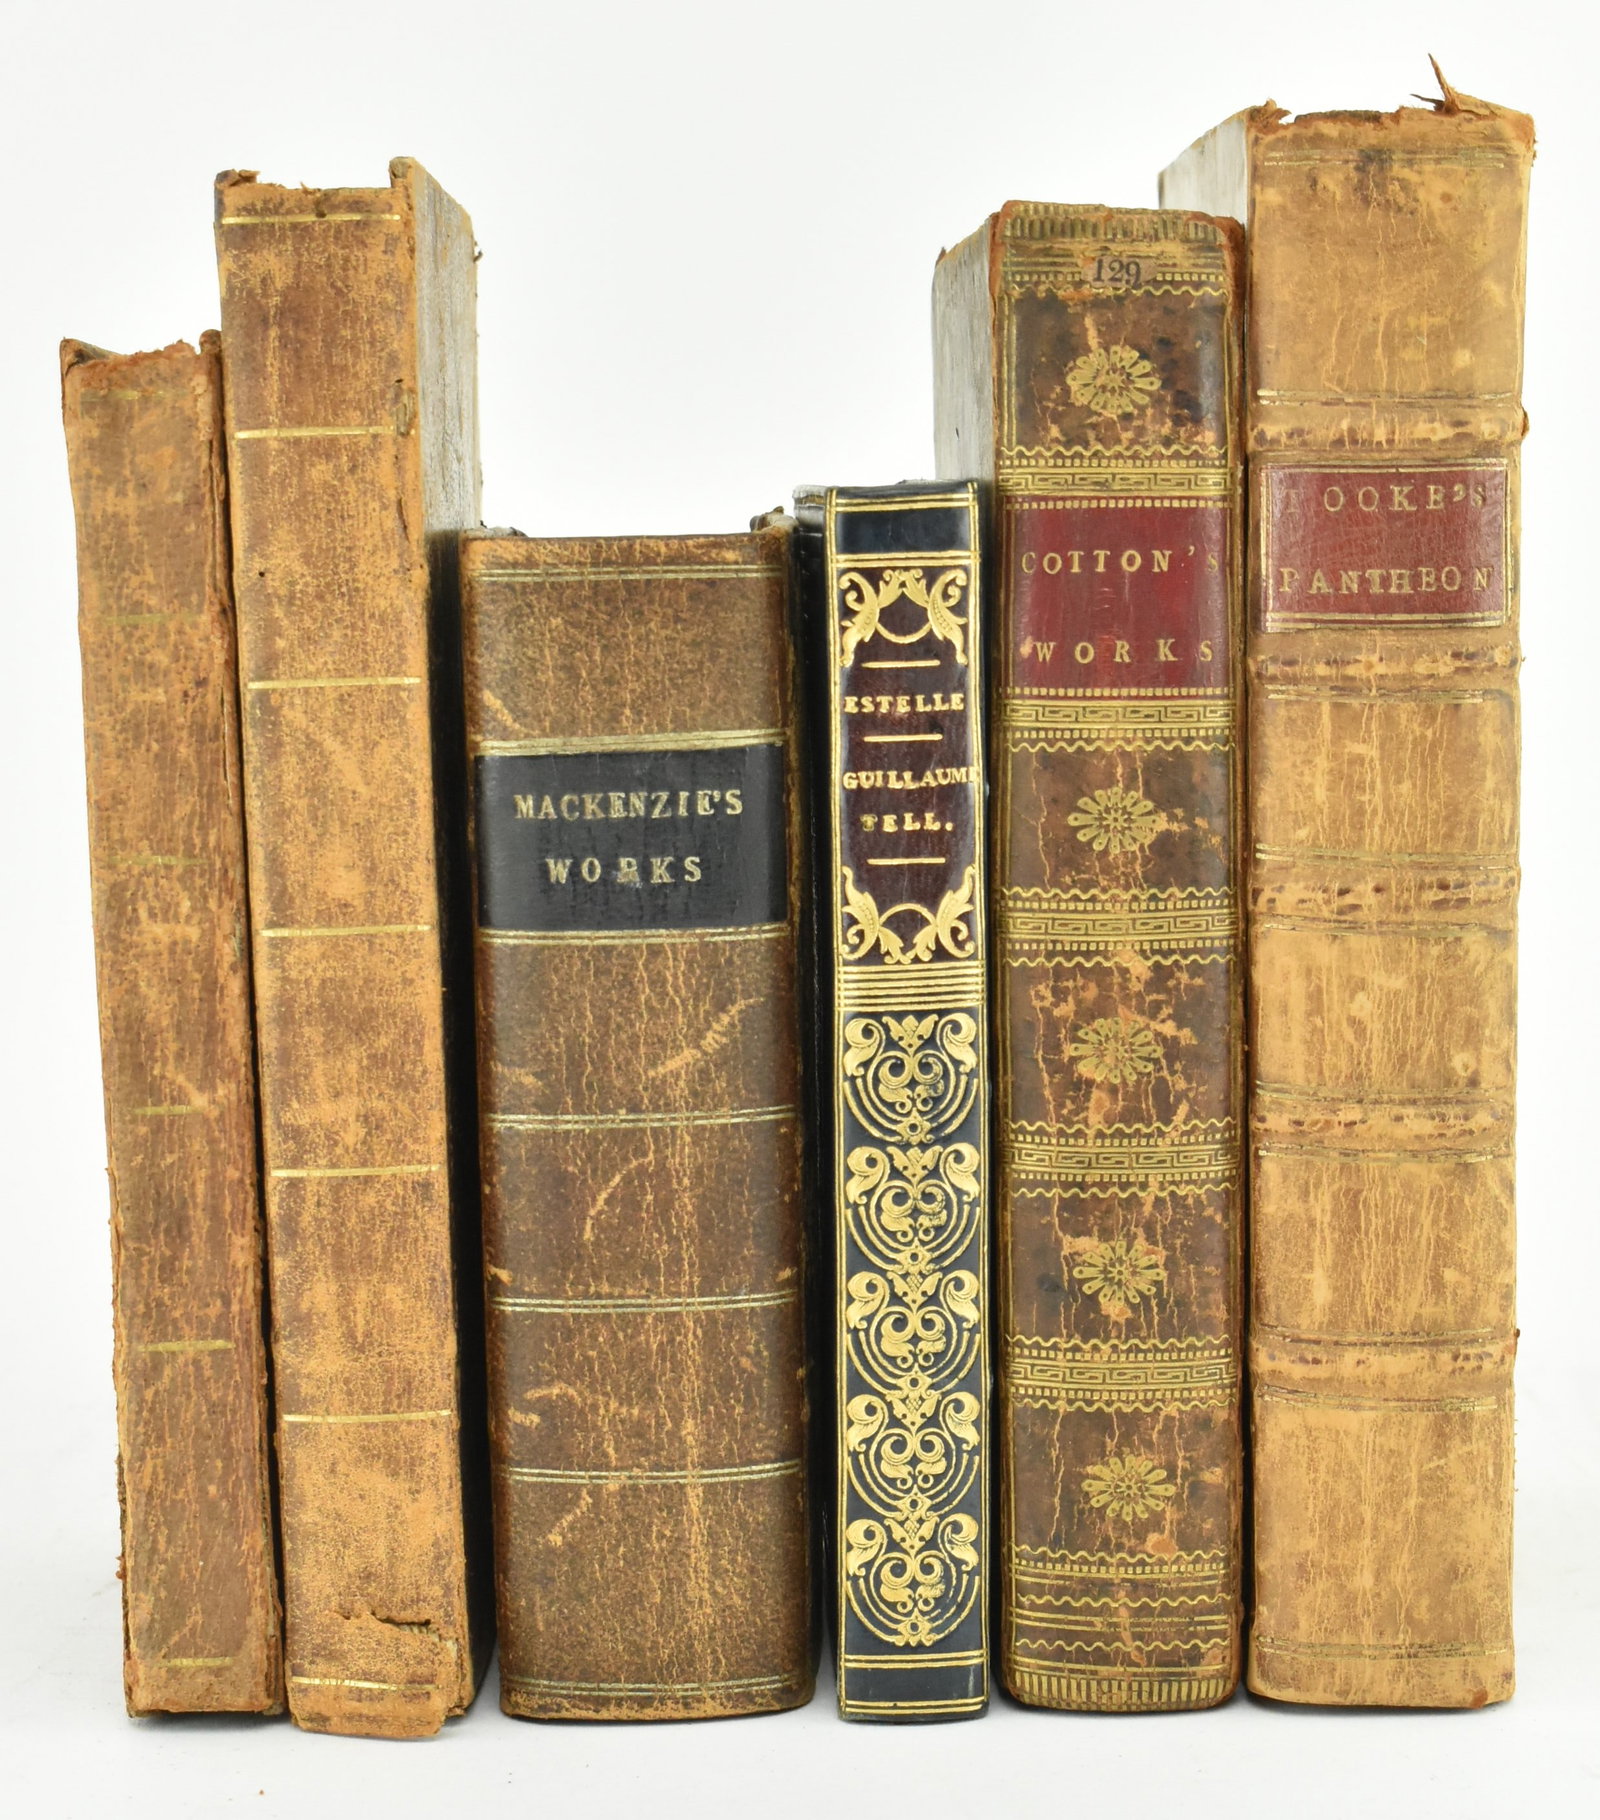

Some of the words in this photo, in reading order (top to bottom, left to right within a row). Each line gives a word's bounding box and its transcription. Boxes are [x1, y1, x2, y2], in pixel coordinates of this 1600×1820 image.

[1093, 258, 1141, 290] 129
[1021, 545, 1219, 574] COTTON'S
[1279, 566, 1494, 594] PANTHEON
[1034, 638, 1214, 664] WORKS
[844, 693, 965, 714] ESTELLE
[513, 789, 743, 821] MACKENZIE'S
[860, 812, 954, 833] TELL.
[545, 856, 702, 885] WORKS
